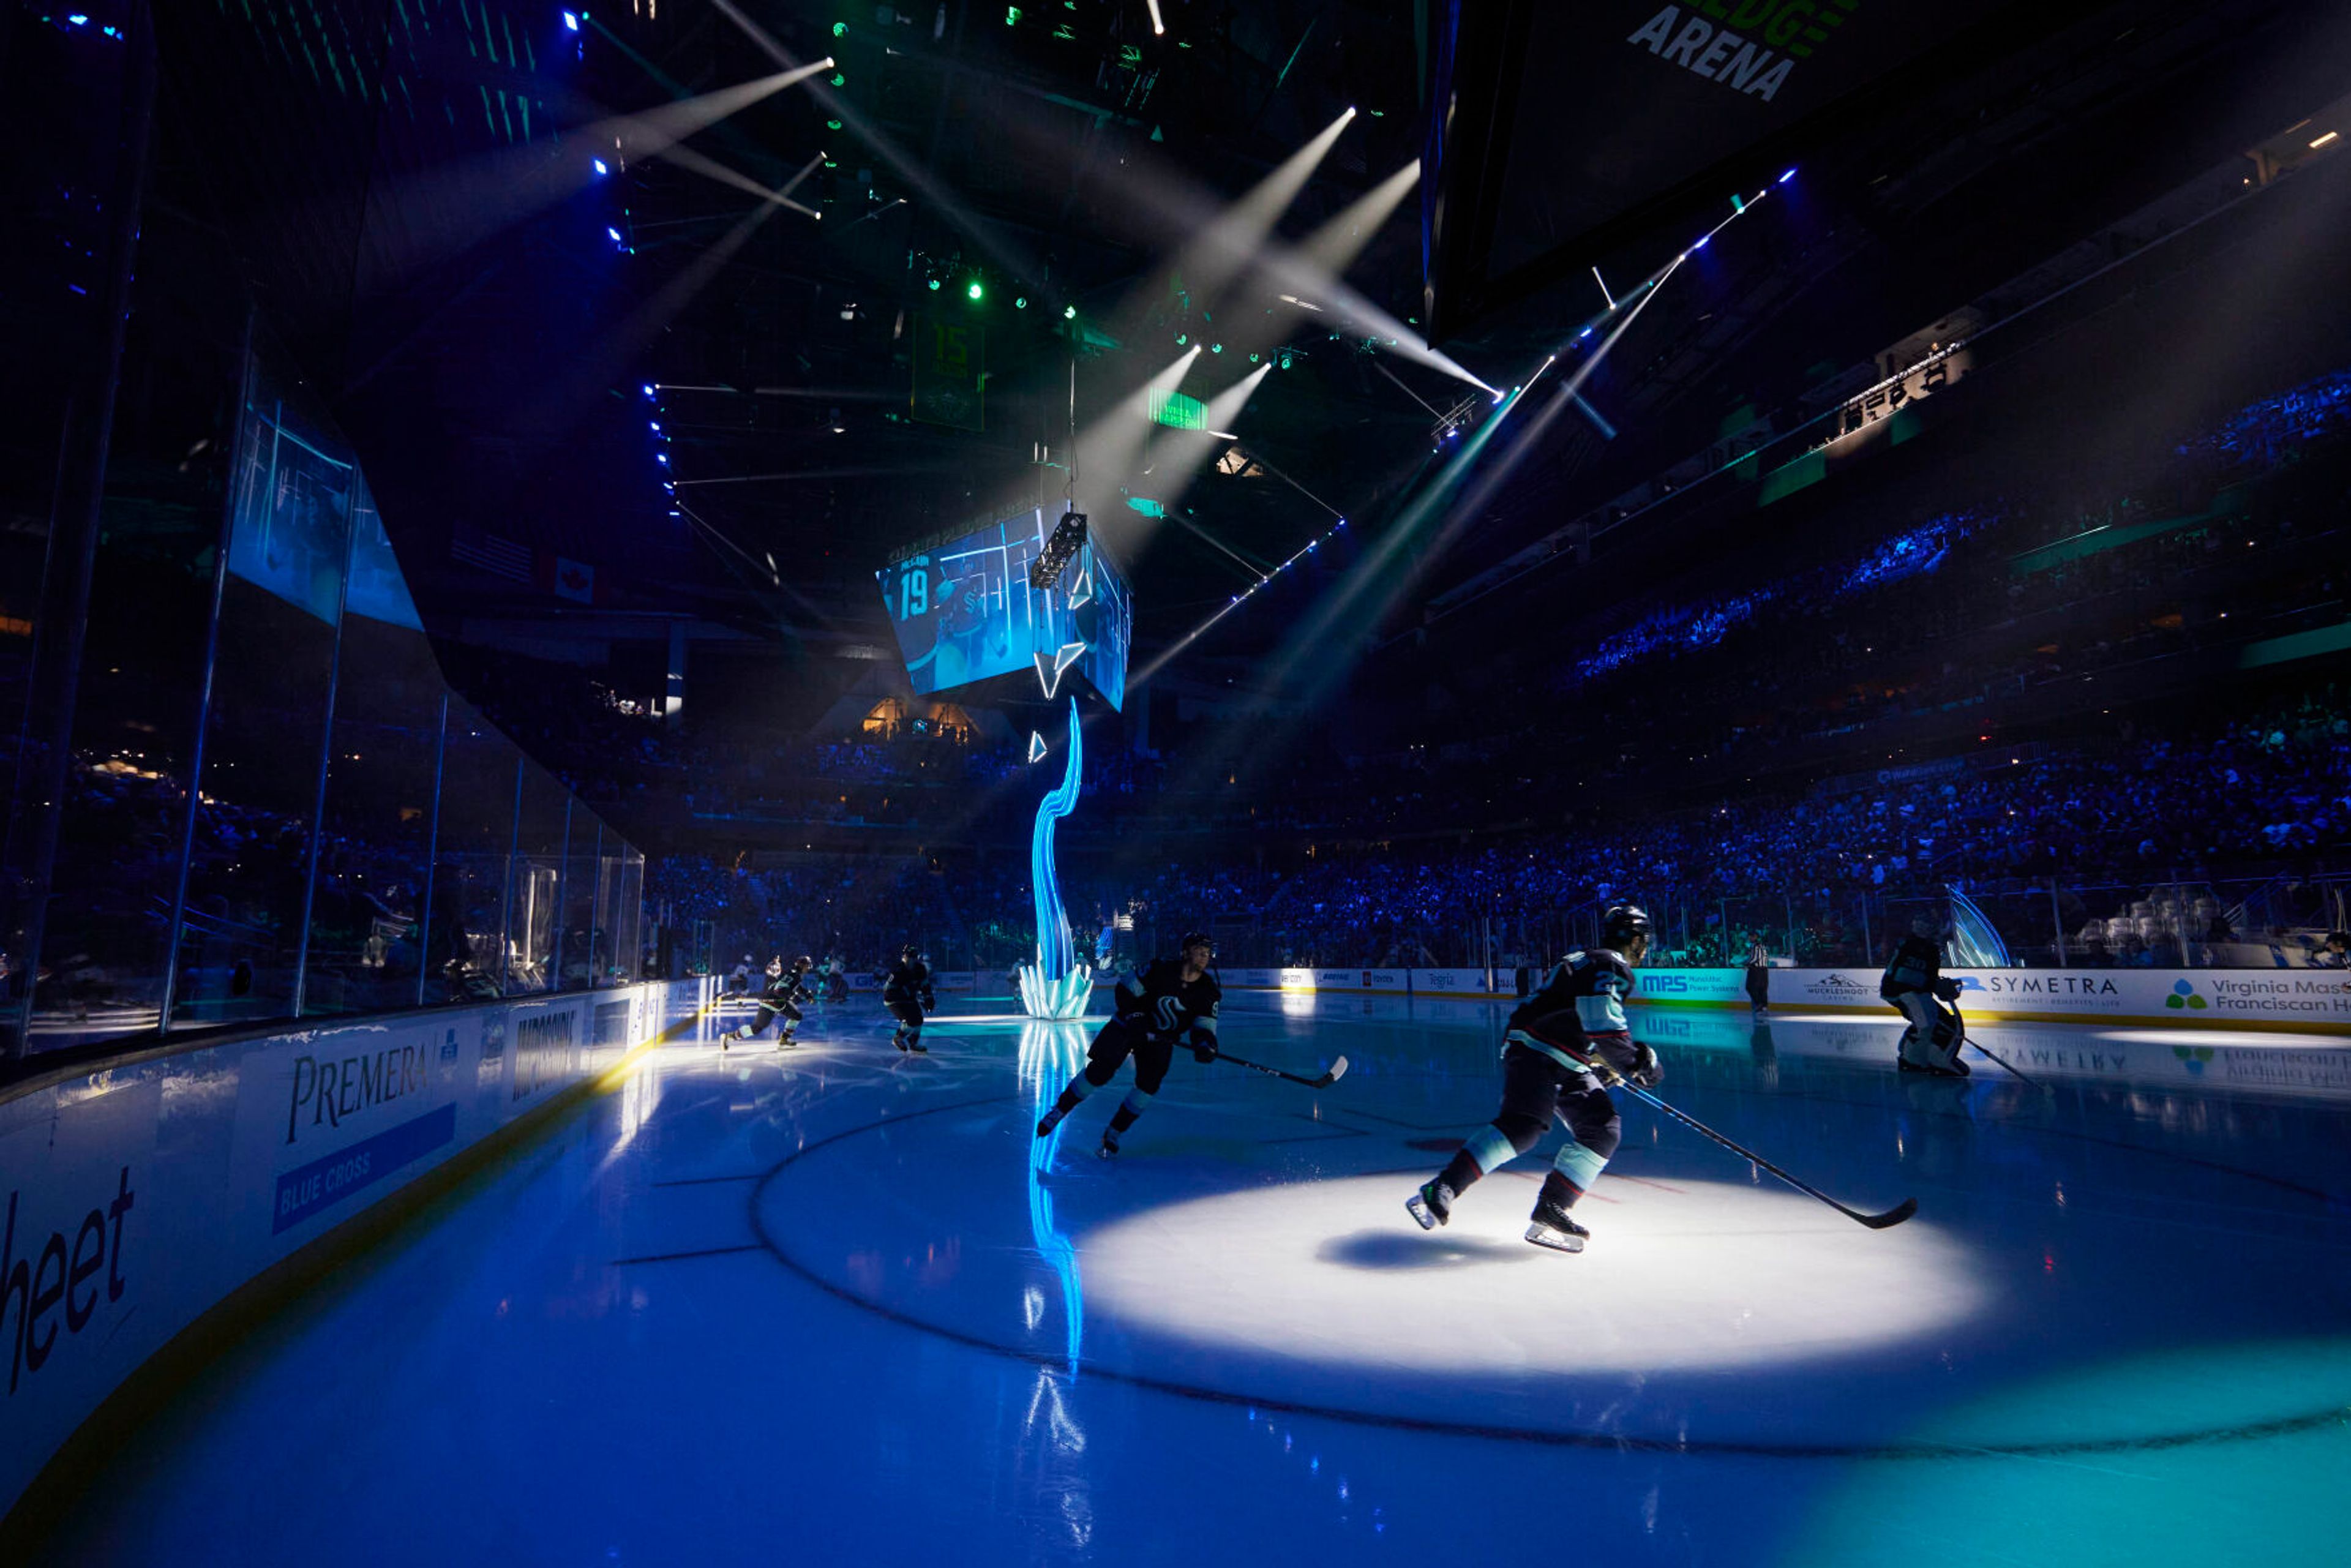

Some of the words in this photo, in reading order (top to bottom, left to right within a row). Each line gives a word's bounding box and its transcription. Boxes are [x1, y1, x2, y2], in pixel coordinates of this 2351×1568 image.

[1626, 4, 1795, 103] ARENA
[900, 569, 929, 621] 19
[1643, 976, 1688, 992] MPS
[1991, 977, 2118, 994] SYMETRA
[2212, 980, 2289, 997] Virginia
[2216, 996, 2327, 1011] Franciscan
[2333, 999, 2351, 1012] H
[285, 1043, 427, 1145] PREMERA
[280, 1173, 322, 1215] BLUE
[325, 1151, 372, 1193] CROSS
